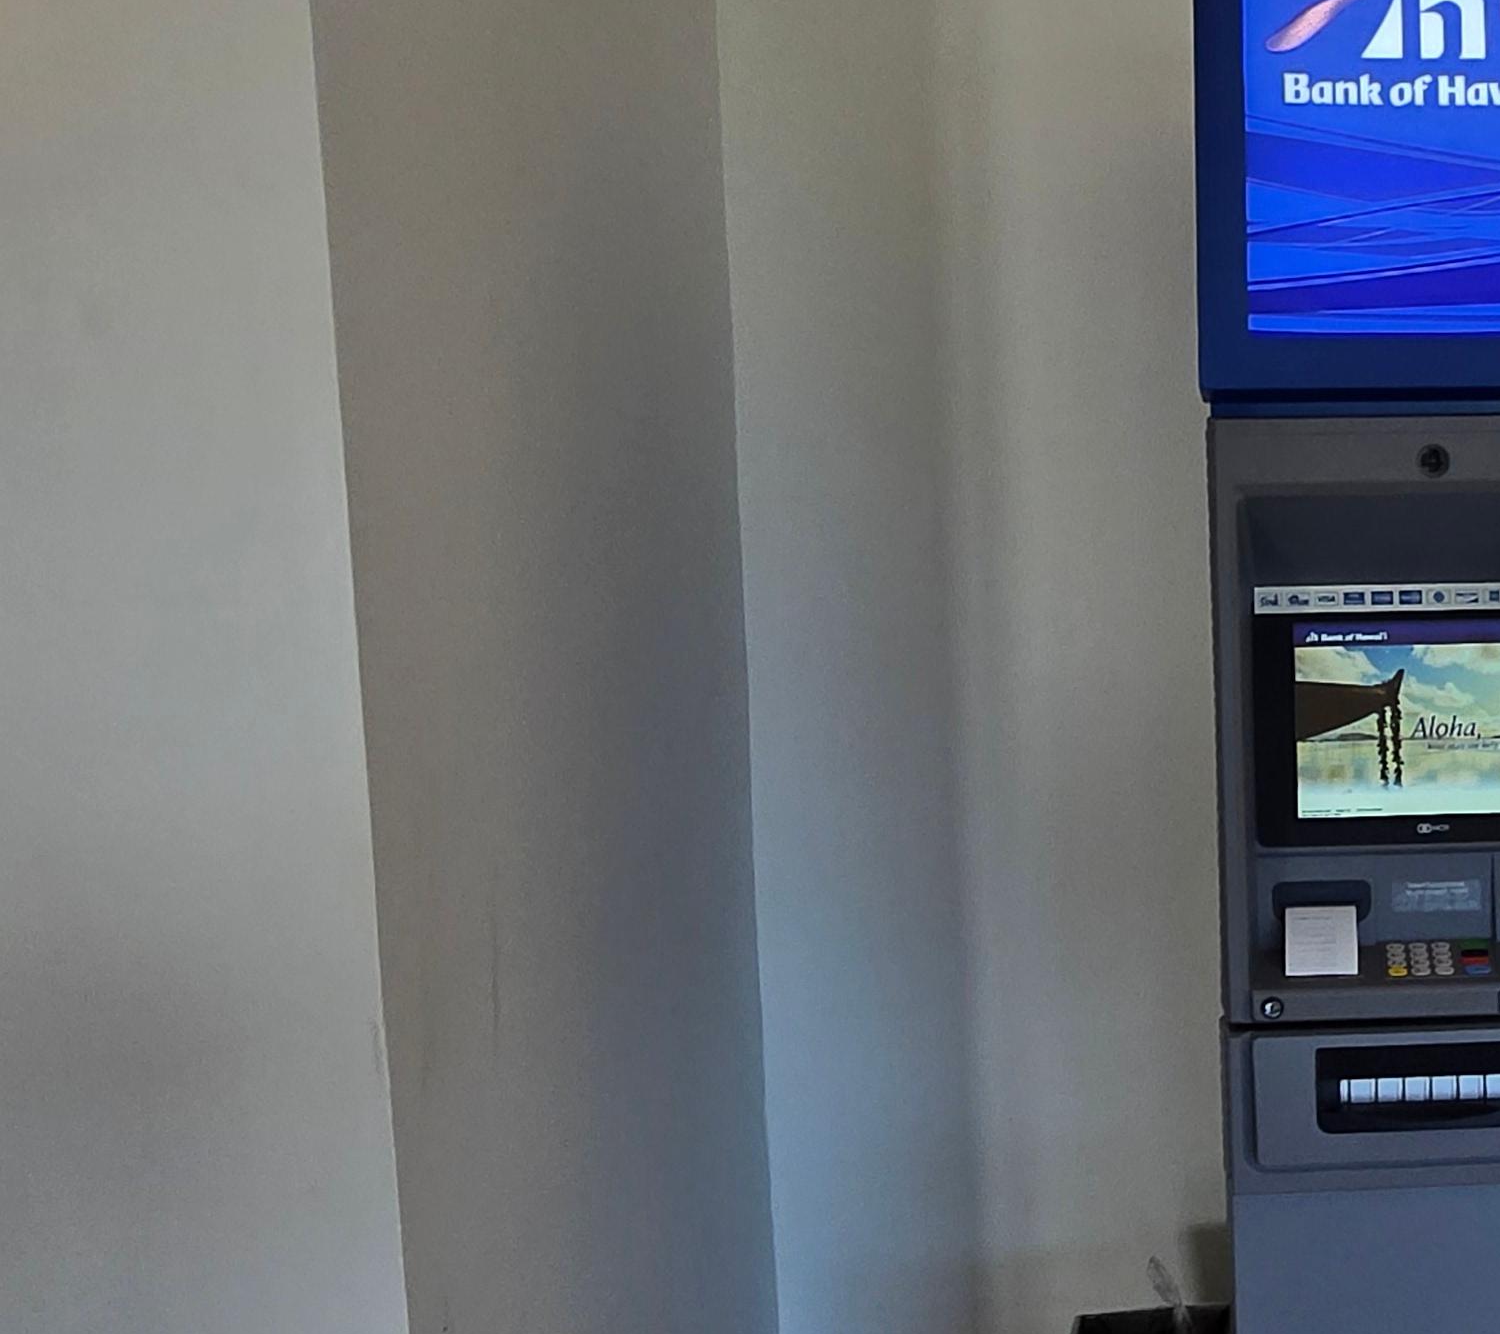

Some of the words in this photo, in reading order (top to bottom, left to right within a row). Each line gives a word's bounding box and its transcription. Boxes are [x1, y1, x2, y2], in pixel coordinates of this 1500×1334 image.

[1283, 72, 1384, 106] Bank
[1389, 74, 1432, 107] of
[1409, 714, 1482, 740] Aloha,
